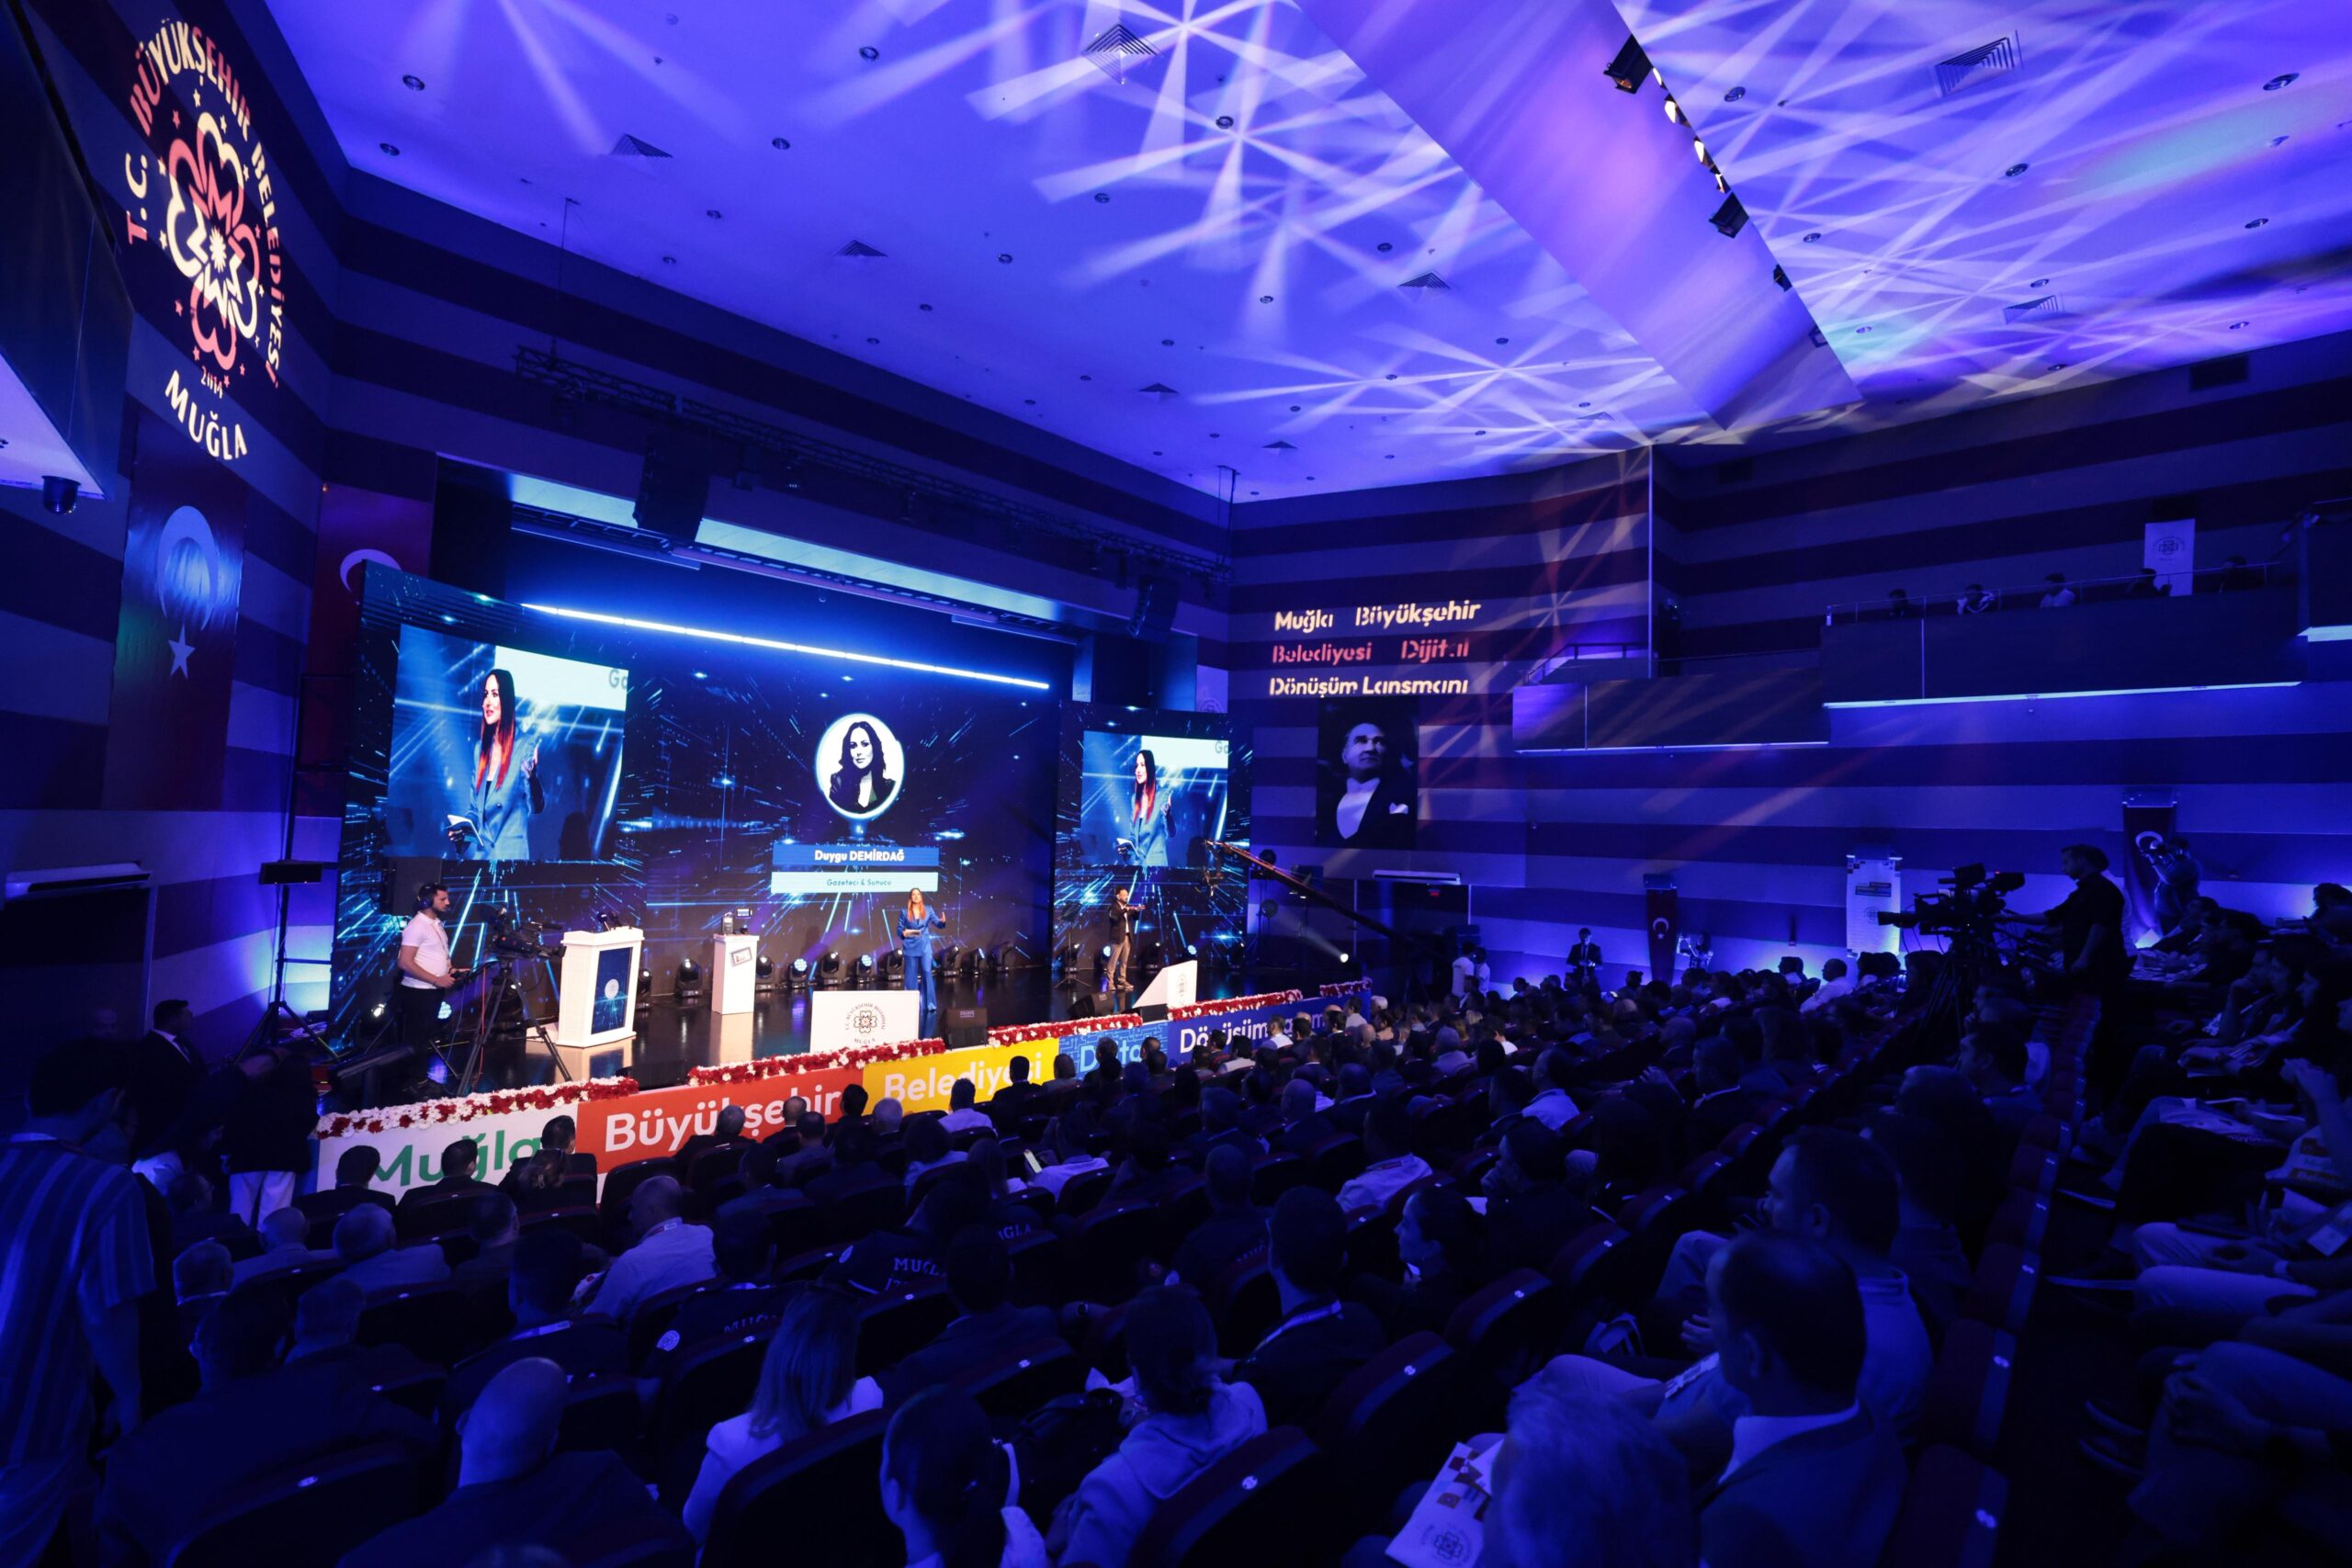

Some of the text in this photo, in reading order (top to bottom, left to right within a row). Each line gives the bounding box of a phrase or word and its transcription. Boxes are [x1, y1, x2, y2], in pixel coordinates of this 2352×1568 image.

[164, 370, 247, 461] MUĞLA
[1355, 600, 1481, 629] Büyükşehir
[1272, 642, 1373, 666] Belediyesi
[1269, 676, 1358, 698] Dönüşüm
[814, 848, 905, 863] Duygu DEMİRDAĞ
[605, 1084, 842, 1153] Büyüşeir
[884, 1052, 1043, 1102] Belediyi
[1181, 1018, 1268, 1054] Döüüm
